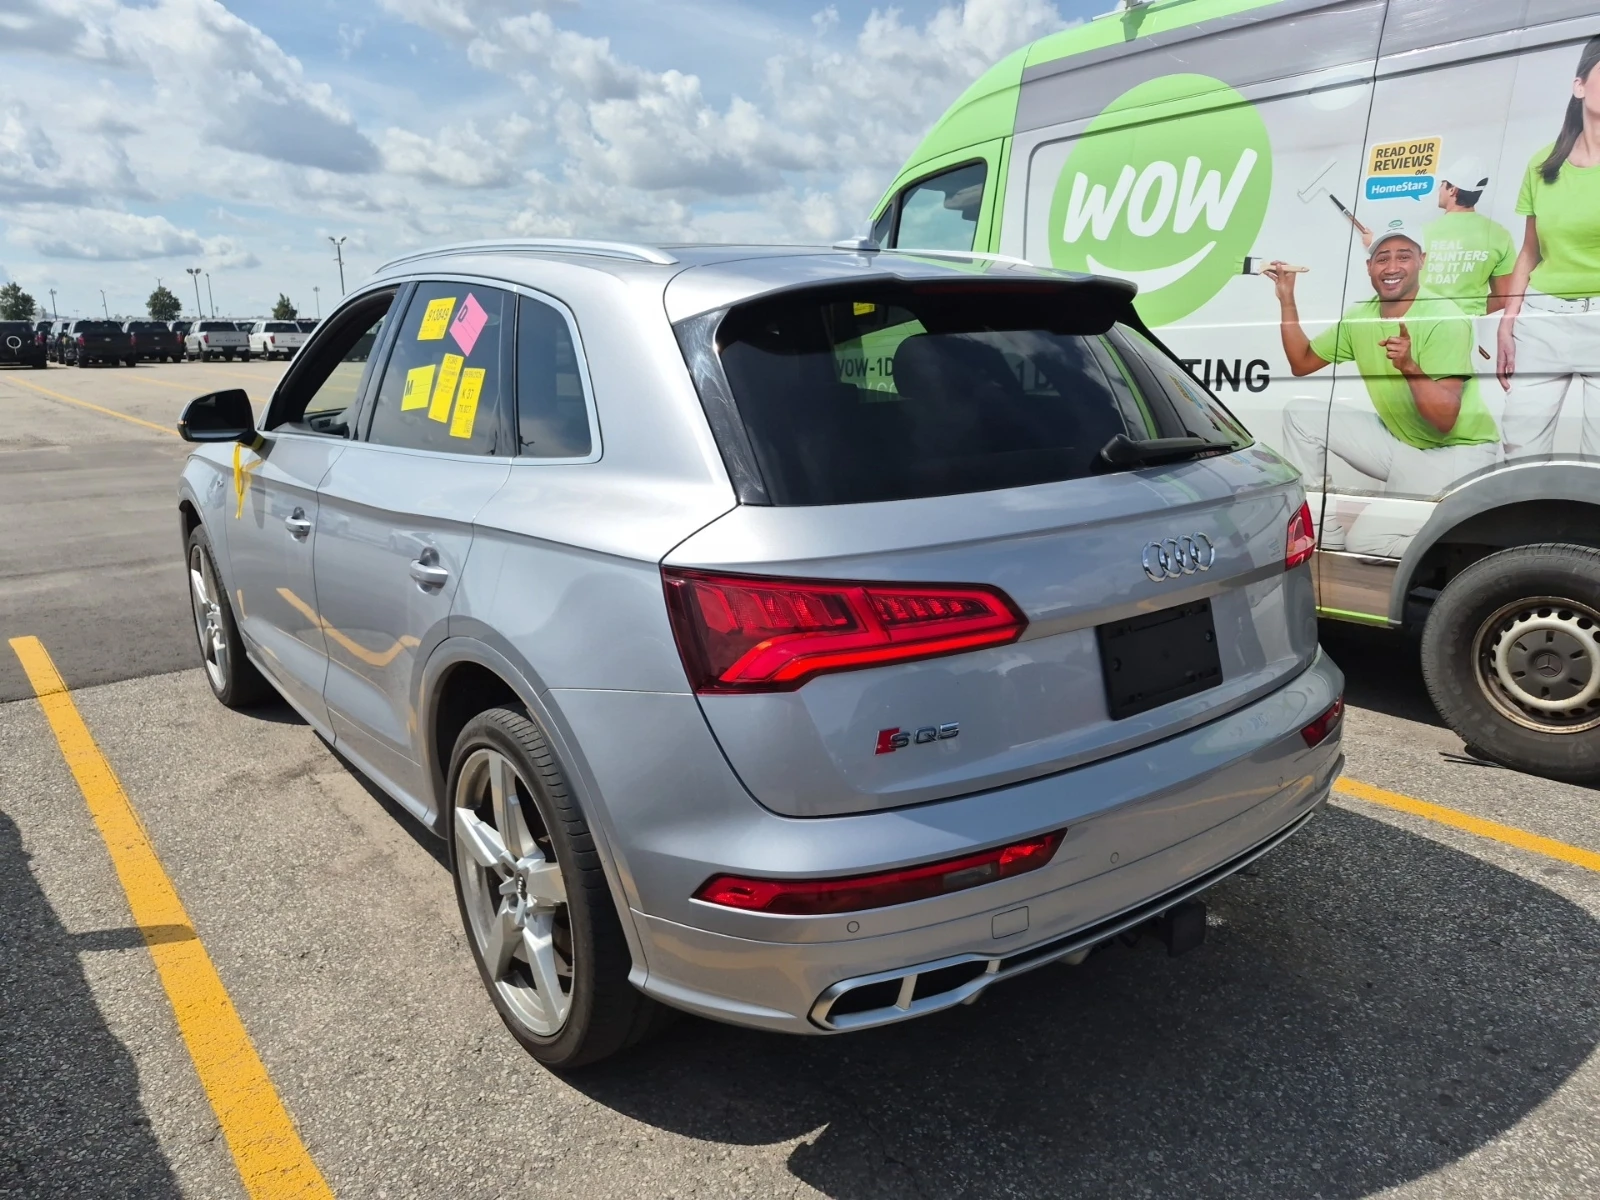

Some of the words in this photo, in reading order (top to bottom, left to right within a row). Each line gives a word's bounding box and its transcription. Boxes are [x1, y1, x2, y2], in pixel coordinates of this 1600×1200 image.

[1376, 146, 1406, 159] READ
[1408, 142, 1435, 155] OUR
[1373, 154, 1433, 172] REVIEWS
[1415, 168, 1428, 176] on
[1371, 181, 1428, 194] HomeStars
[1063, 148, 1258, 243] WOW
[1431, 240, 1463, 251] REAL
[1428, 250, 1489, 262] PAINTERS
[1447, 262, 1460, 272] IT
[1462, 261, 1475, 272] IN
[1425, 273, 1432, 284] A
[1435, 273, 1460, 285] DAY
[458, 305, 468, 322] D
[405, 380, 414, 396] M
[889, 722, 959, 749] SQ5
